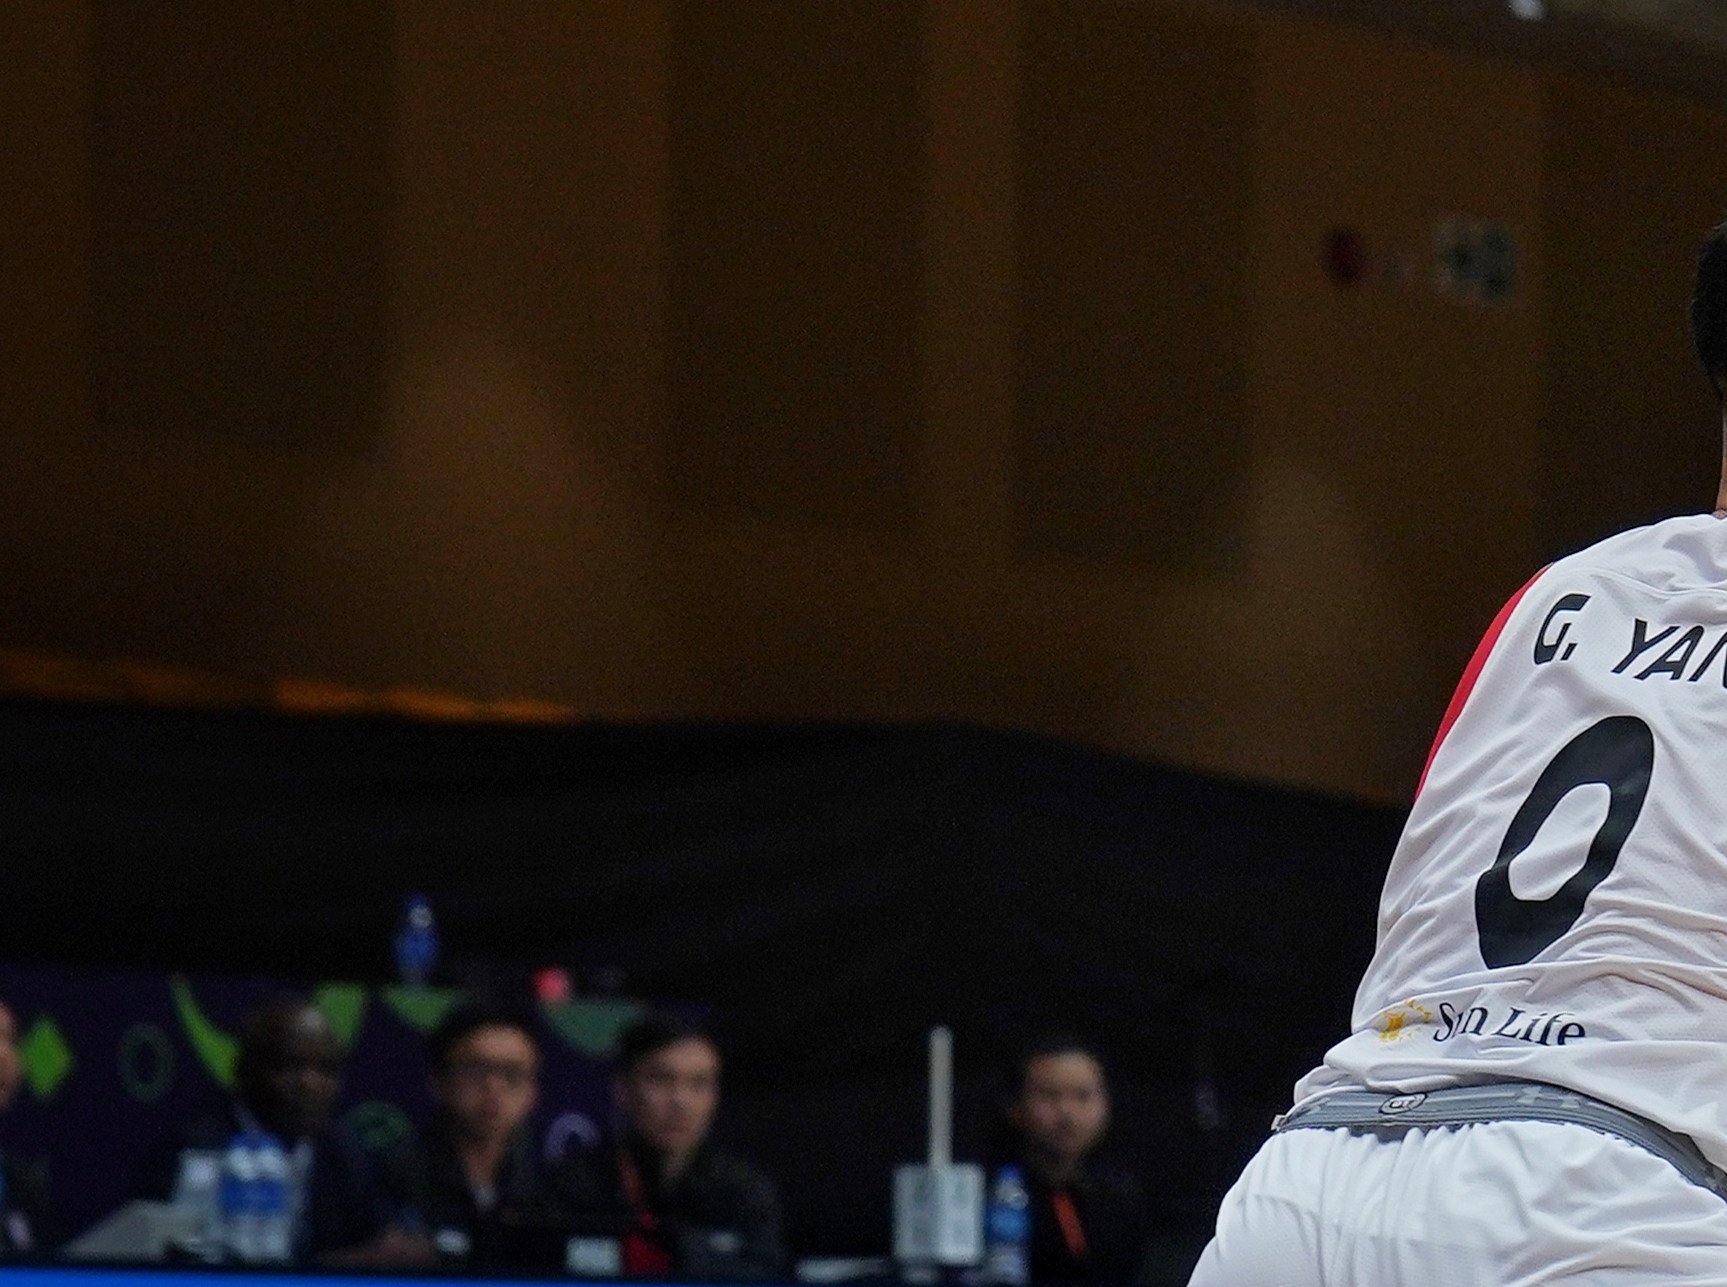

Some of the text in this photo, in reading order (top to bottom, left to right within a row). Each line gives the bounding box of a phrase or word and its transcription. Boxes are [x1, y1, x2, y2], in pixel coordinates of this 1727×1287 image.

[1534, 593, 1591, 665] G.
[1475, 715, 1655, 970] 0
[1493, 1006, 1586, 1046] Life
